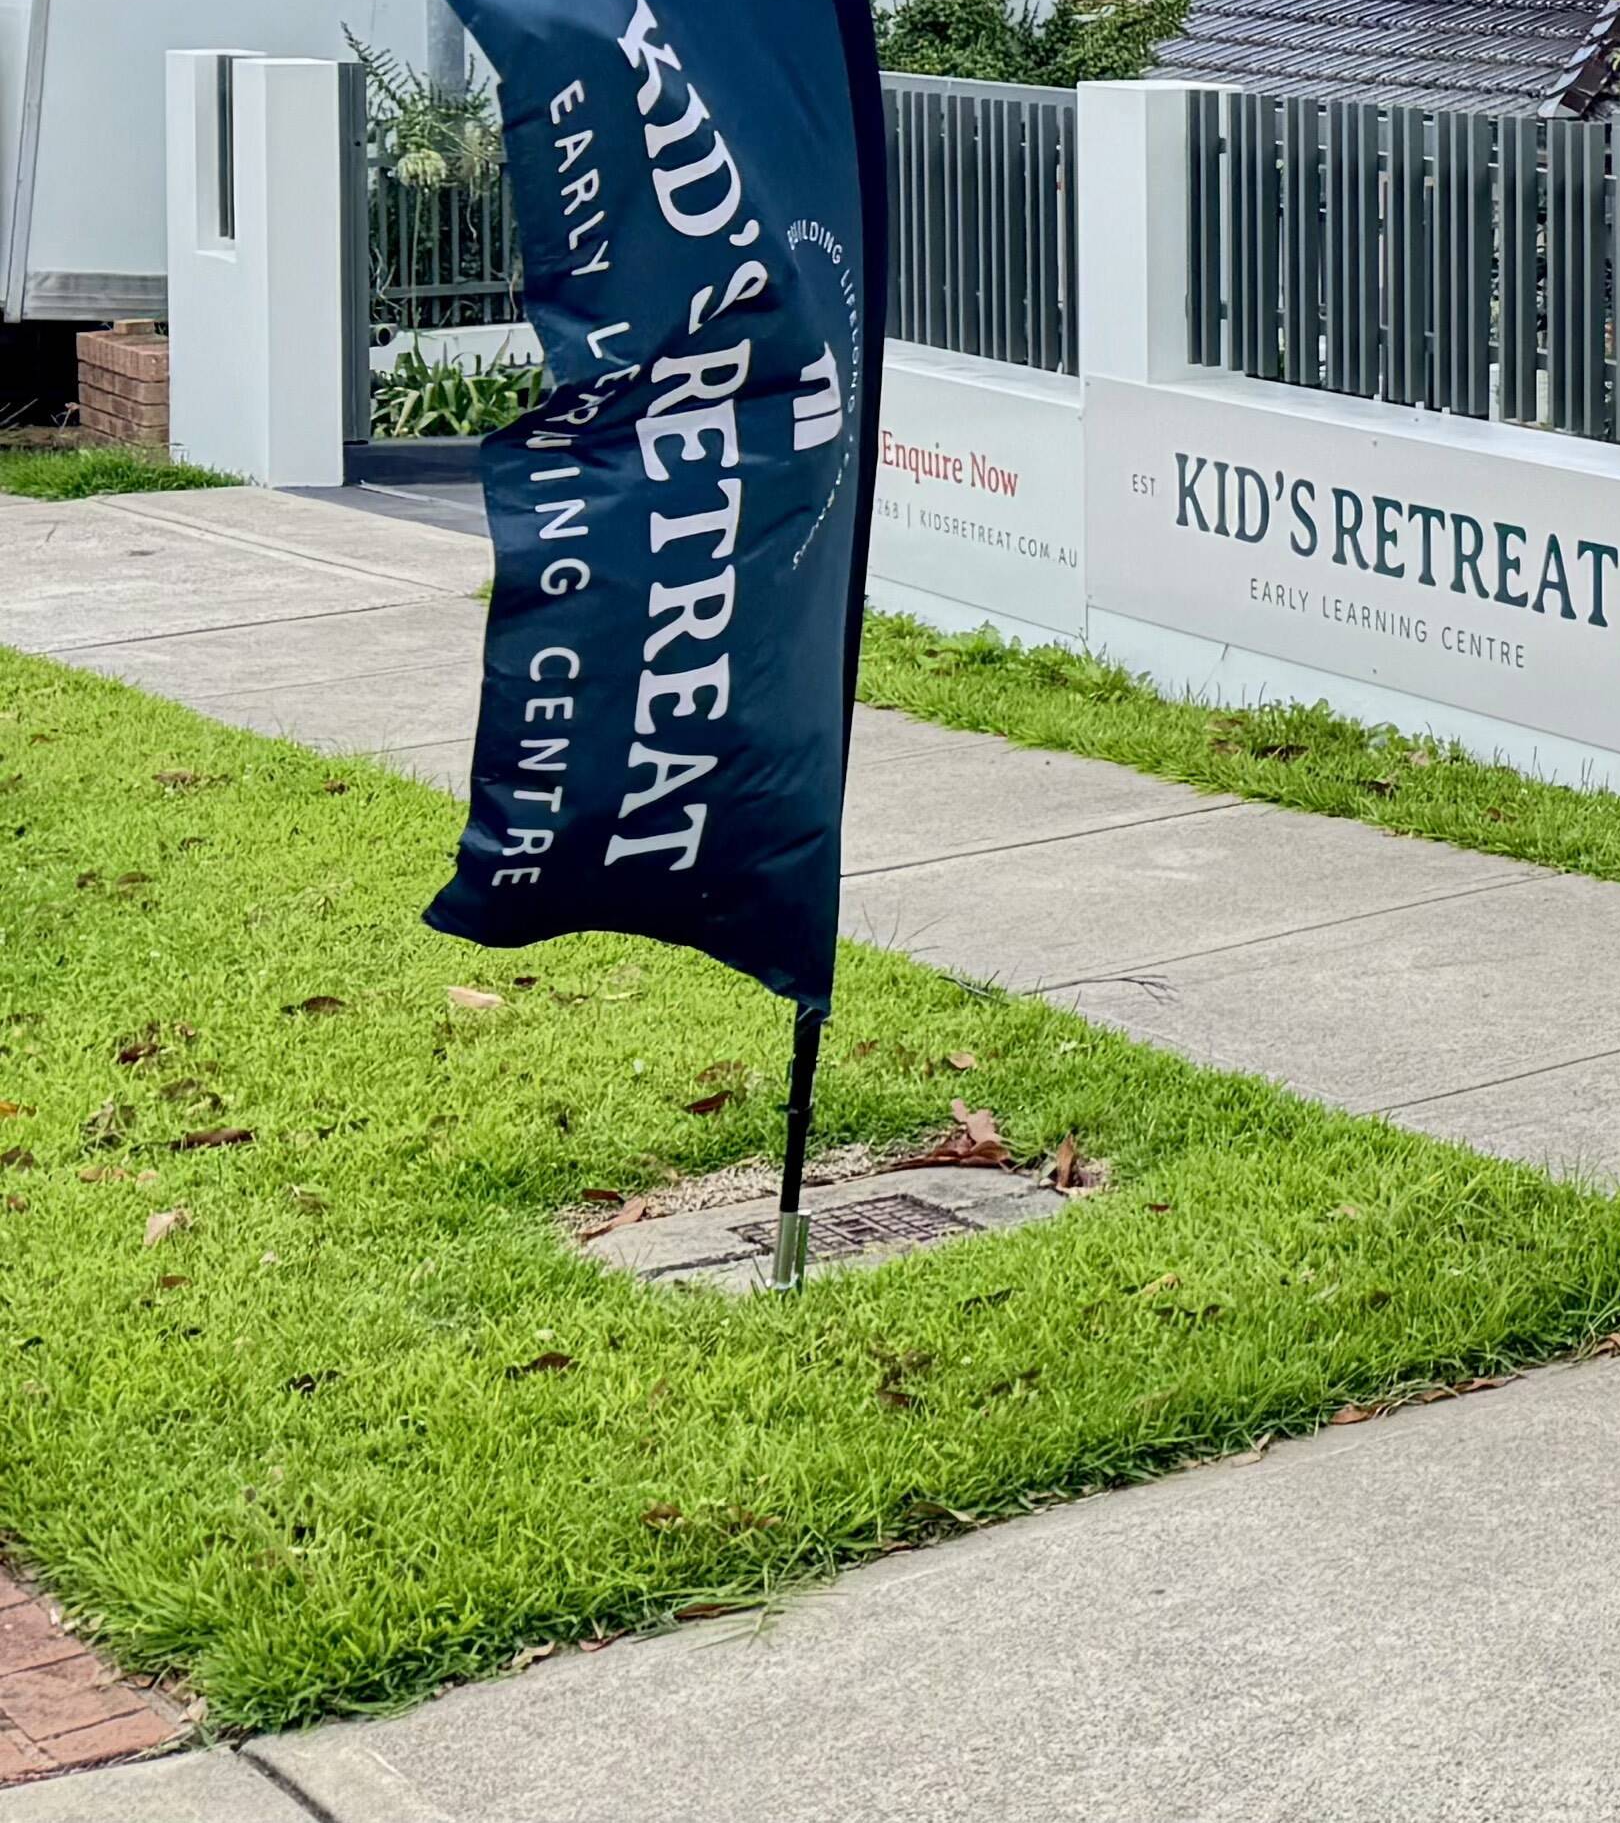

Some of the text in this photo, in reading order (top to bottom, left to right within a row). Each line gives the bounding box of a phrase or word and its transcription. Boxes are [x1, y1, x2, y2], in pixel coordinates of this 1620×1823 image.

[549, 79, 610, 276] EARLY
[881, 430, 1018, 497] Enquire Now
[1131, 473, 1156, 497] EST
[1175, 452, 1619, 628] KID'S RETREAT
[604, 339, 751, 872] RETREAT
[1249, 578, 1526, 669] EARLY LEARNING CENTRE
[492, 647, 580, 887] CENTRE
